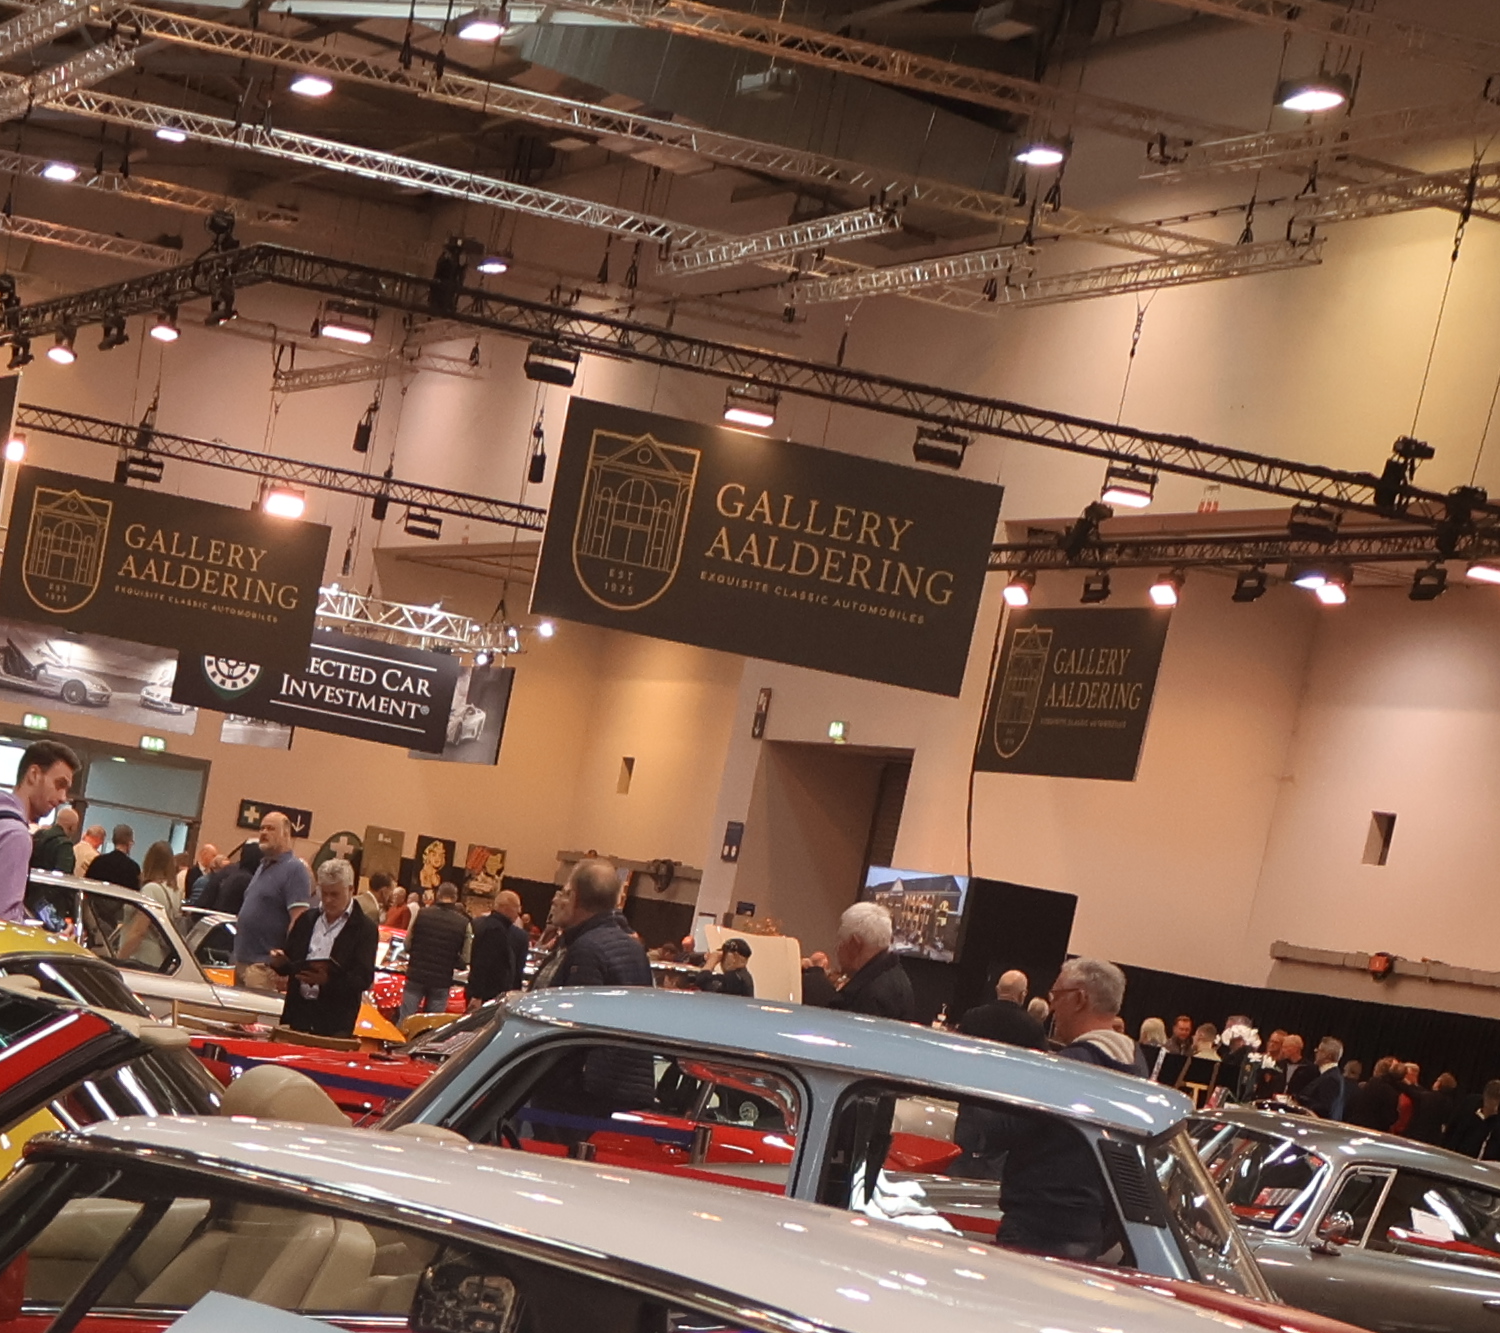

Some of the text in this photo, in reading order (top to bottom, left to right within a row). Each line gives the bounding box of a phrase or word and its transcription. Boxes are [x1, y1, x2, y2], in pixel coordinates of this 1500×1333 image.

[717, 483, 914, 552] GALLERY
[125, 524, 267, 573] GALLERY
[704, 526, 955, 605] AALDERING
[117, 555, 299, 610] AALDERING
[700, 570, 926, 625] EXQUISITE CLASSIC AUTOMOBILES
[308, 656, 432, 697] ECTED CAR
[1053, 648, 1131, 676] GALLERY
[1044, 681, 1143, 710] AALDERING
